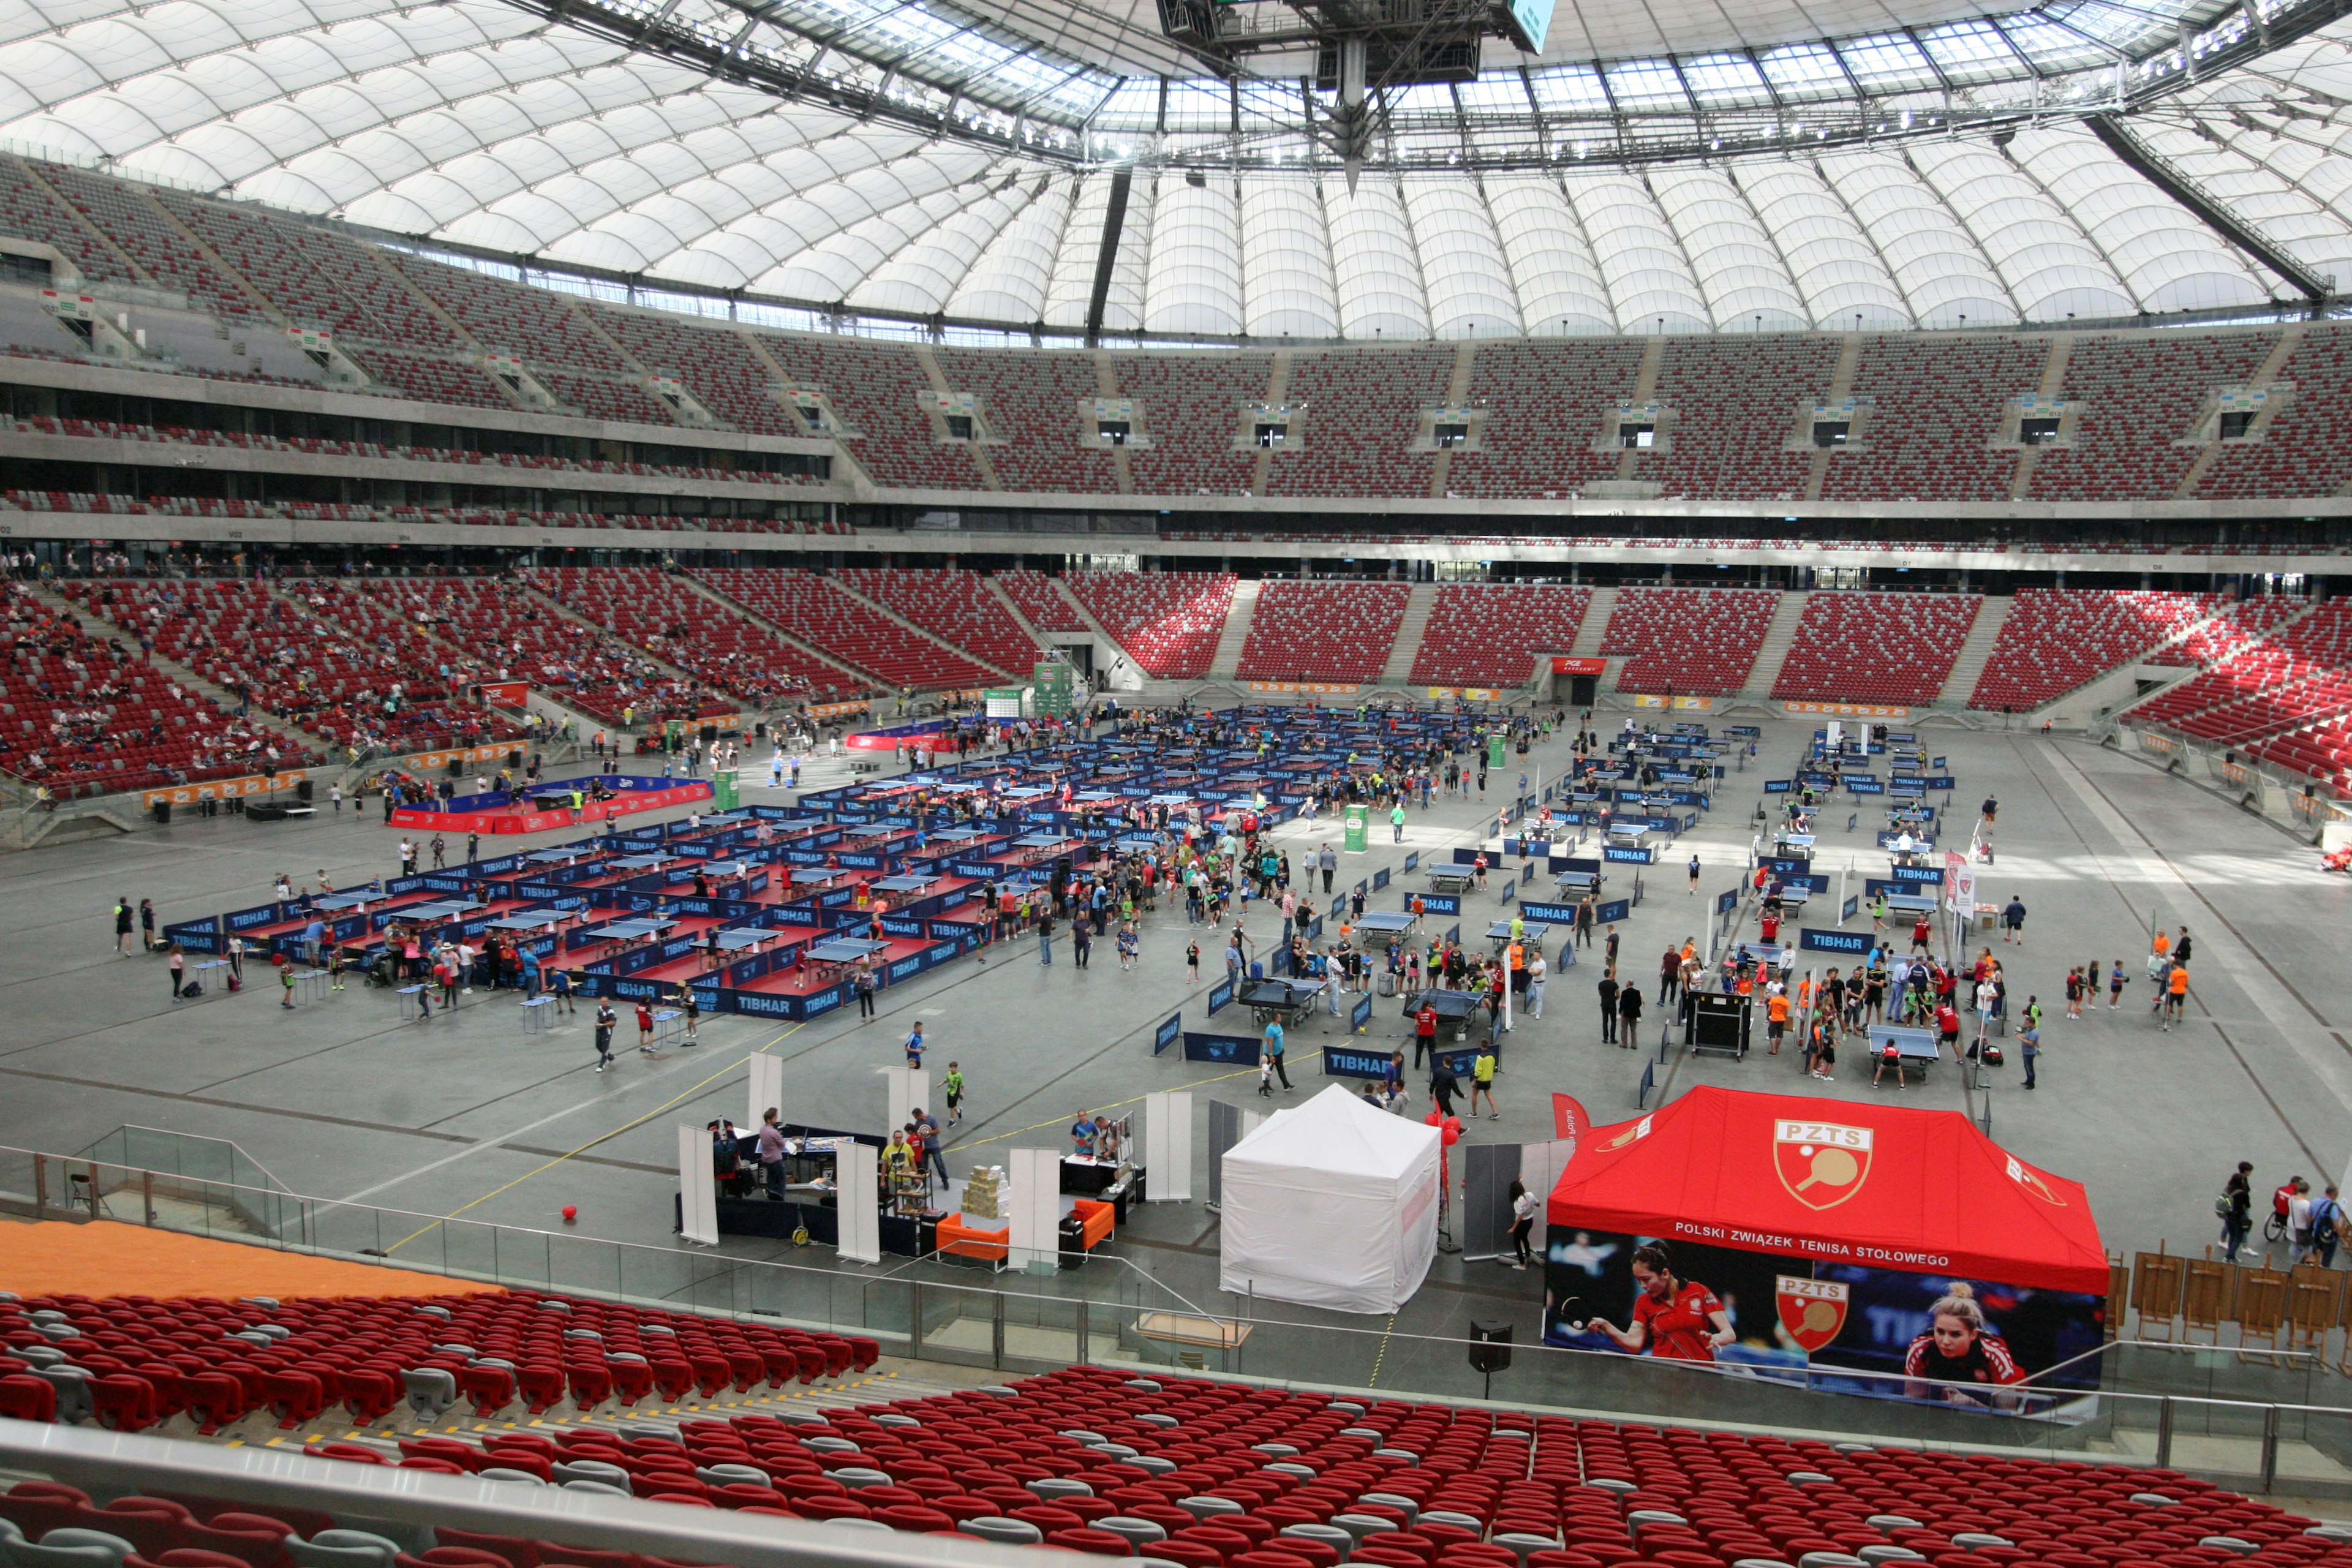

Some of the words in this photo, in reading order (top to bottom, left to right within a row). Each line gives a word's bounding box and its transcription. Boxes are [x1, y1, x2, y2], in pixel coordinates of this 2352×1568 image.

[757, 809, 784, 818] TIBHAR
[840, 856, 875, 867] TIBHAR
[1608, 850, 1646, 861] TIBHAR
[483, 859, 512, 873] TIBHAR
[957, 865, 995, 876] TIBHAR
[1897, 869, 1939, 881] TIBHAR
[393, 879, 423, 892] TIBHAR
[425, 878, 459, 891] TIBHAR
[823, 892, 850, 907] TIBHAR
[233, 910, 270, 927] TIBHAR
[1525, 907, 1569, 920] TIBHAR
[173, 935, 213, 949] TIBHAR
[1813, 934, 1863, 949] TIBHAR
[931, 943, 956, 961] TIBHAR
[892, 959, 919, 976] TIBHAR
[738, 997, 790, 1012] TIBHAR
[805, 991, 839, 1012] TIBHAR
[1787, 1125, 1860, 1145] PZTS
[1675, 1222, 1725, 1238] POLSKI
[1730, 1231, 1792, 1248] ZWIĄZEK
[1800, 1239, 1849, 1255] TENISA
[1856, 1246, 1949, 1266] STOŁOWEGO
[1785, 1280, 1840, 1298] PZTS
